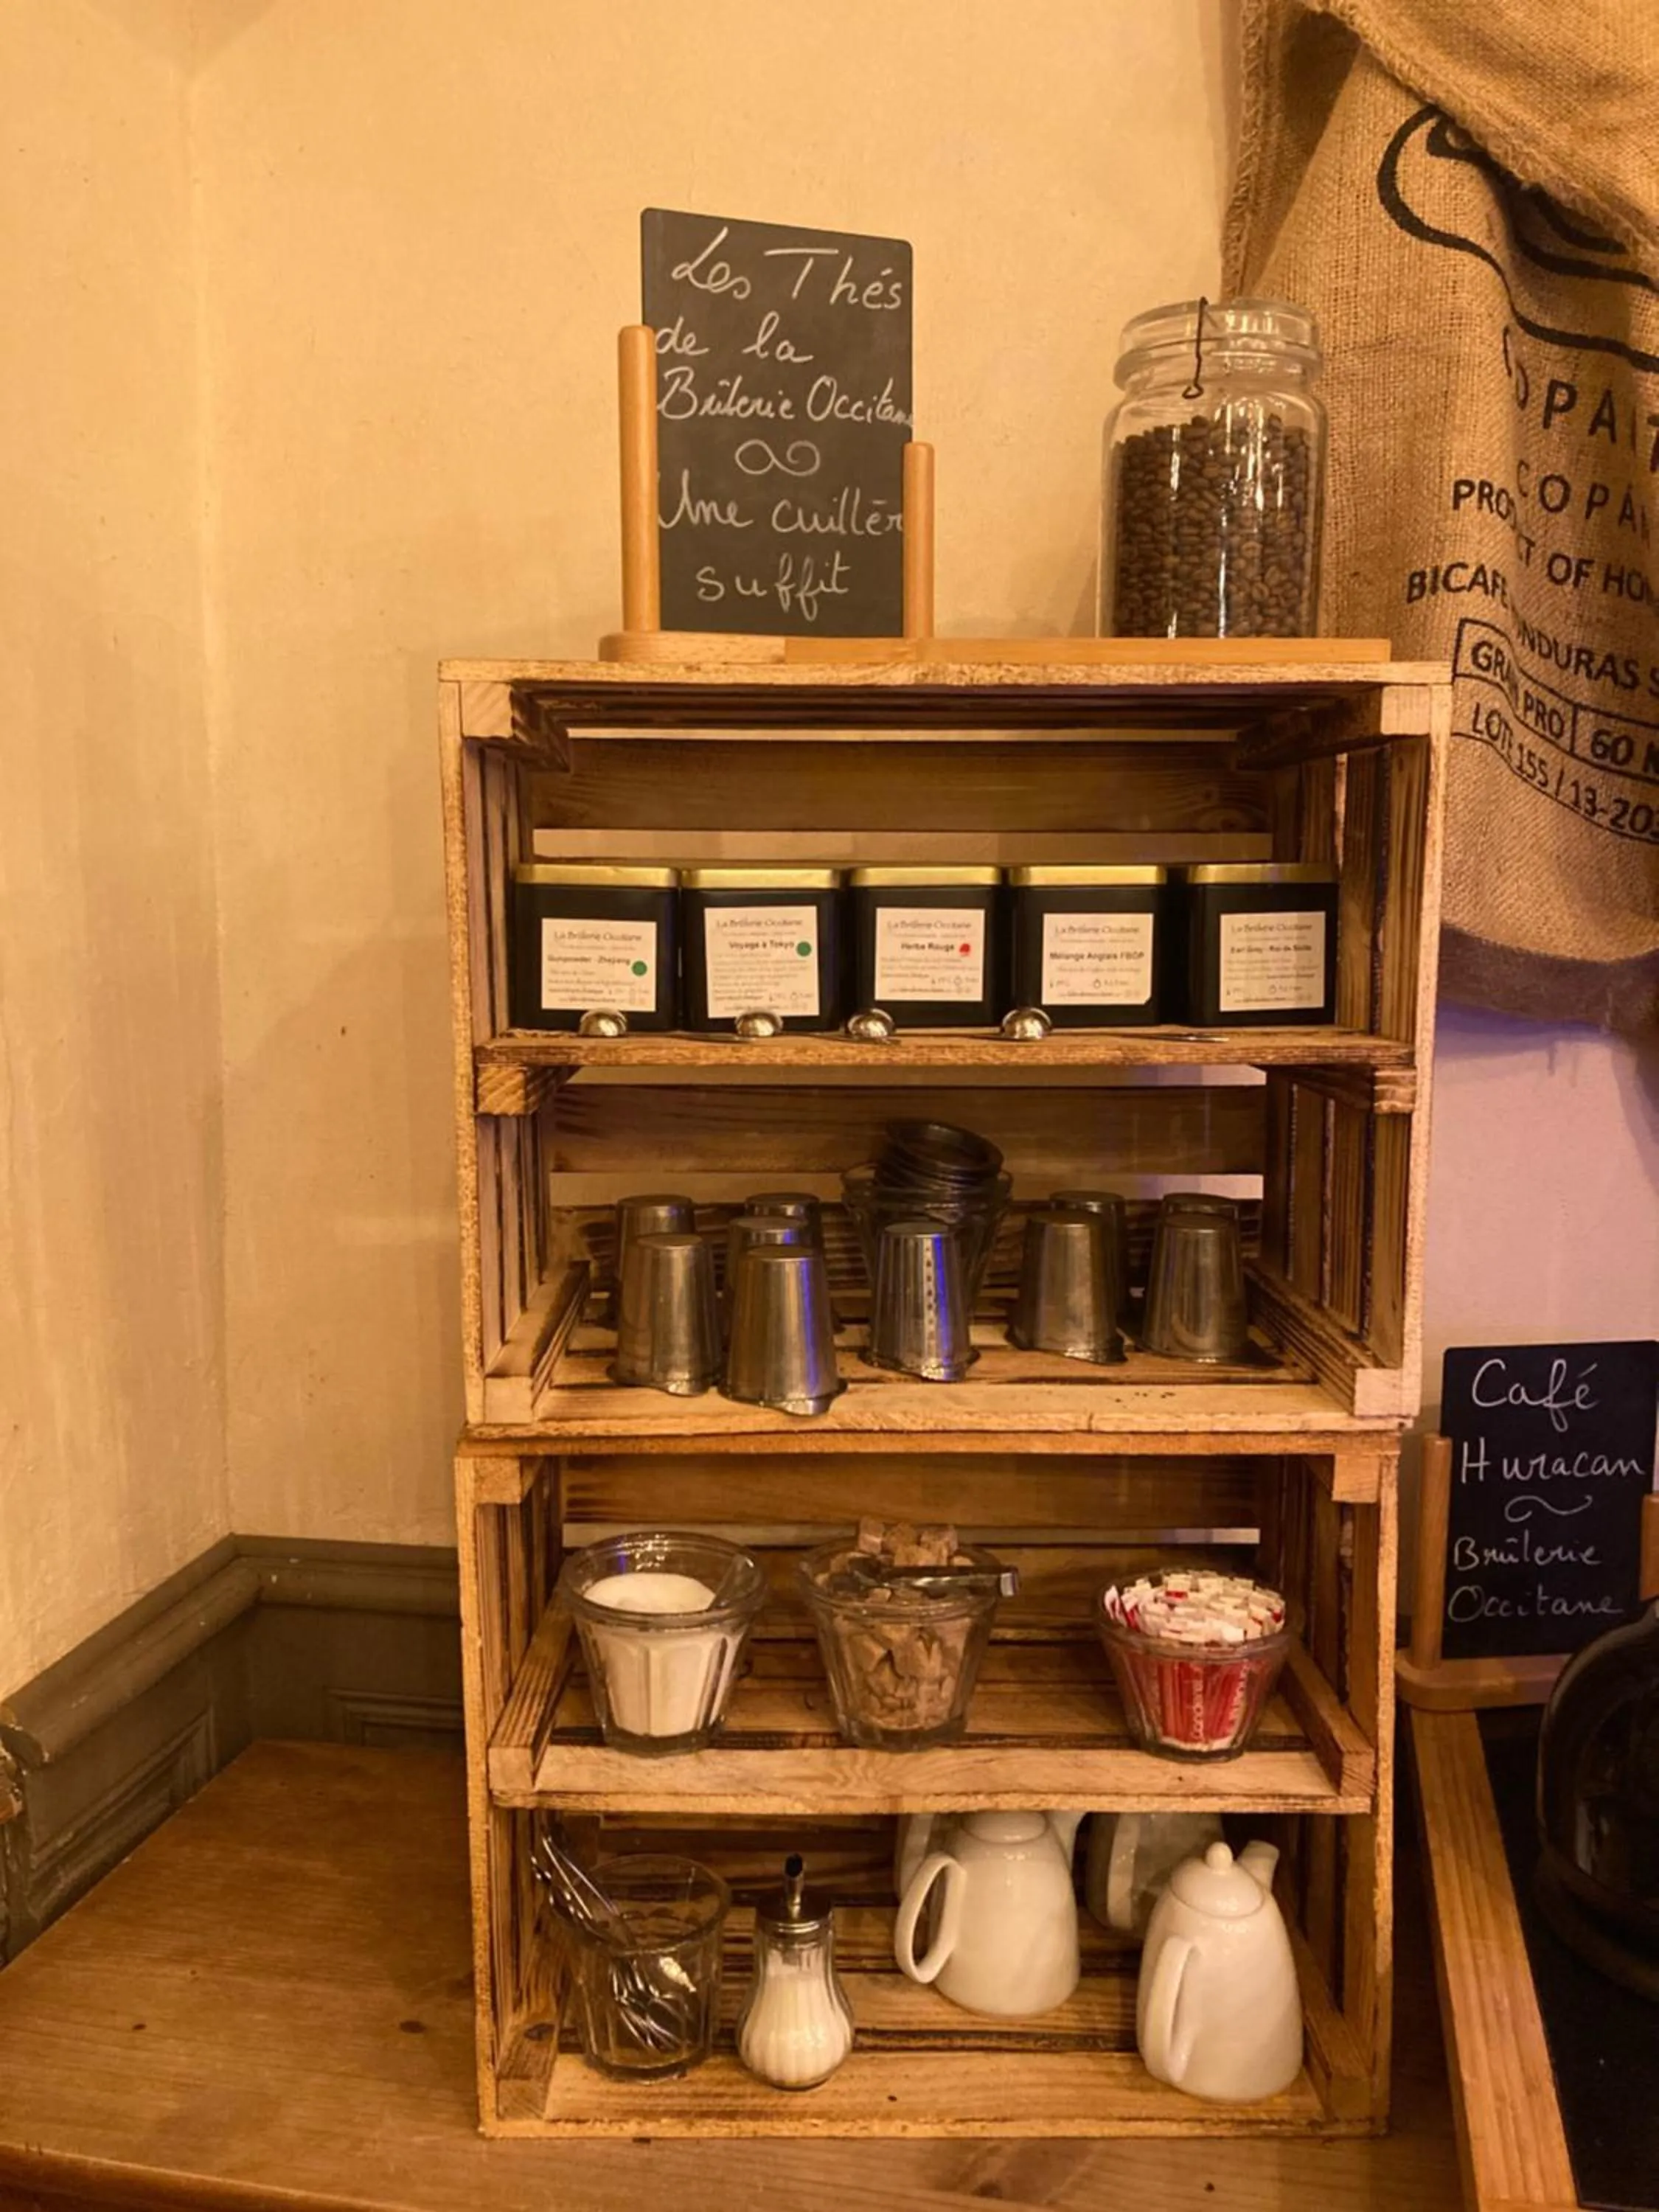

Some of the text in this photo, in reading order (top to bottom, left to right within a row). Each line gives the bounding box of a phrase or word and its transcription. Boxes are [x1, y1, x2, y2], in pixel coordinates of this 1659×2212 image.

[672, 226, 902, 309] Les Thés
[655, 311, 813, 363] de la
[657, 469, 754, 529] Une
[1546, 552, 1595, 589] OF
[1524, 689, 1564, 739] PRO
[1590, 729, 1634, 765] 60
[1472, 1358, 1599, 1432] Café
[1461, 1436, 1645, 1484] Huracan
[1448, 1583, 1623, 1622] Occitane
